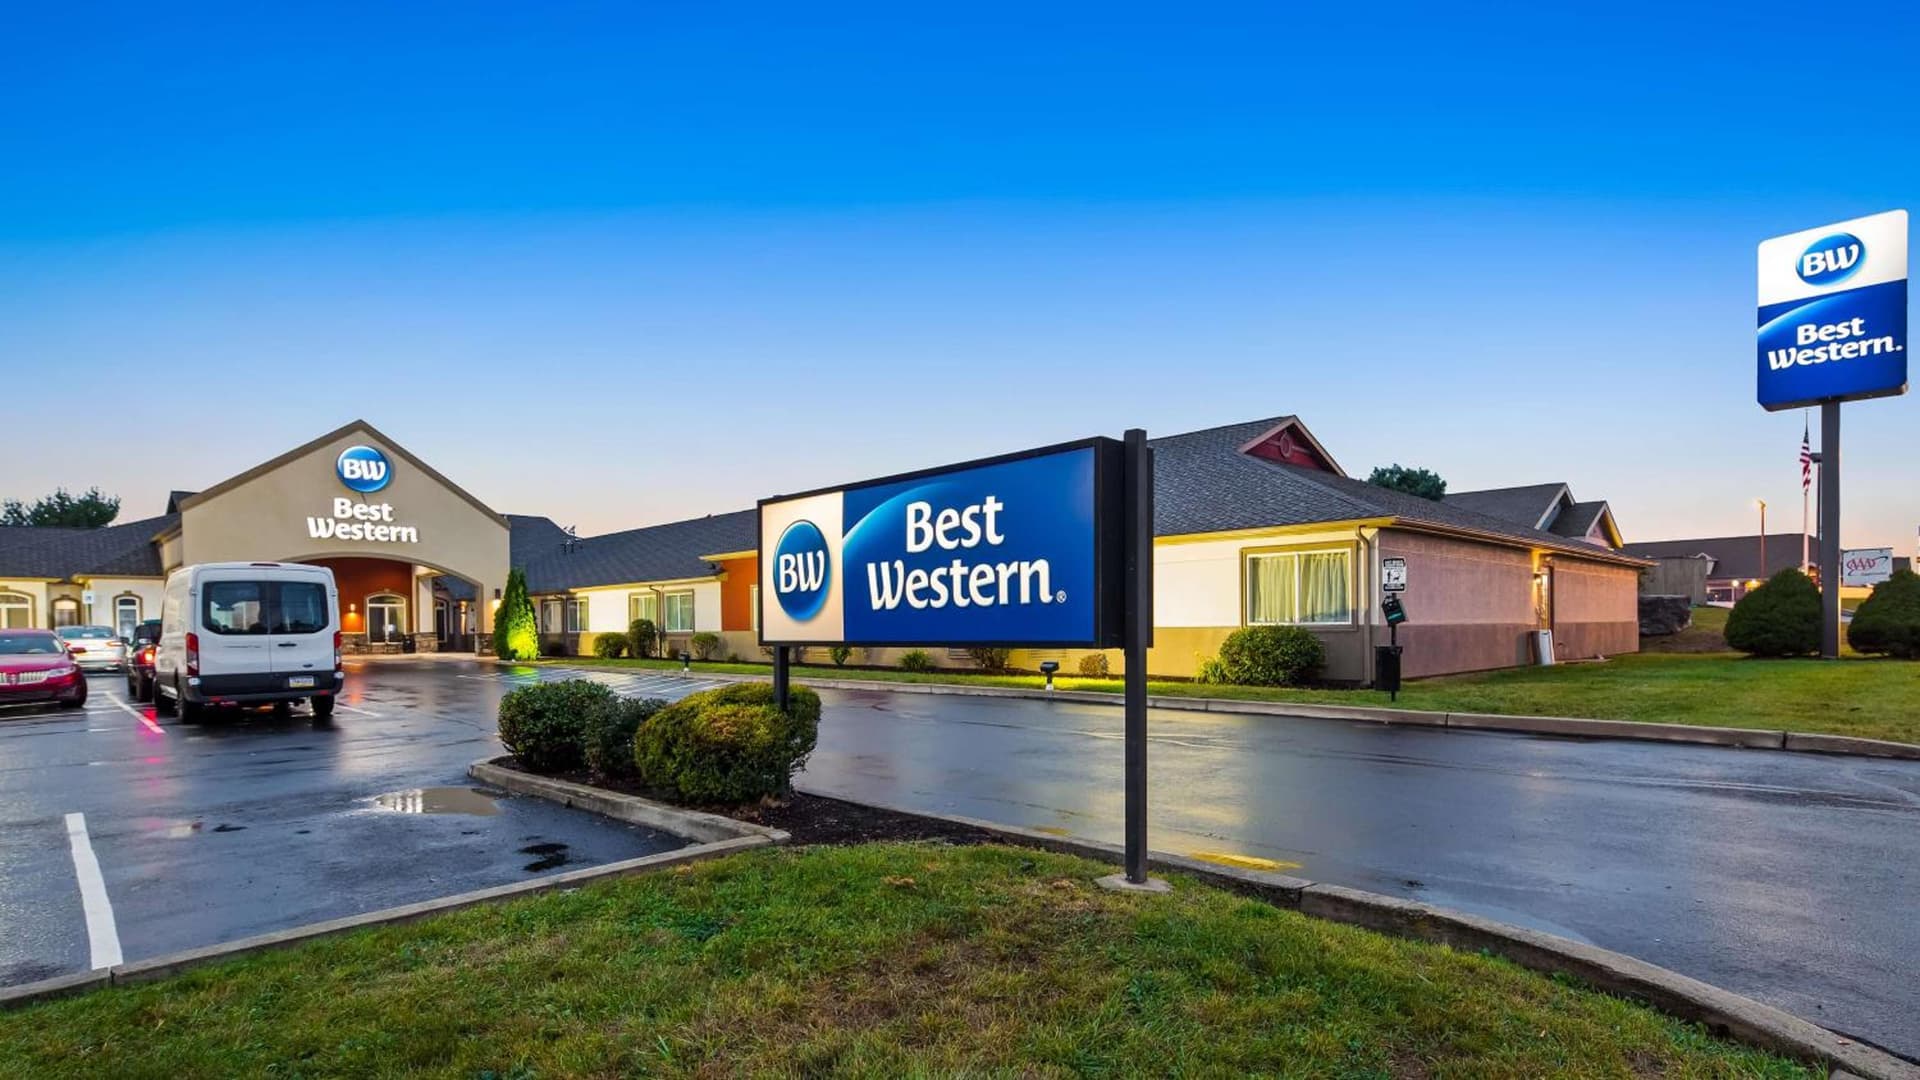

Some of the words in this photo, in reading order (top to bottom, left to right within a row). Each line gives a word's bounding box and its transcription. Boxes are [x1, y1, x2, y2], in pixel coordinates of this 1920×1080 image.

[1803, 244, 1859, 277] BW
[1797, 318, 1865, 346] Best
[343, 459, 386, 481] BW
[333, 498, 393, 522] Best
[906, 495, 1004, 554] Best
[307, 517, 418, 543] Western
[779, 550, 825, 593] BW
[867, 559, 1053, 611] Western
